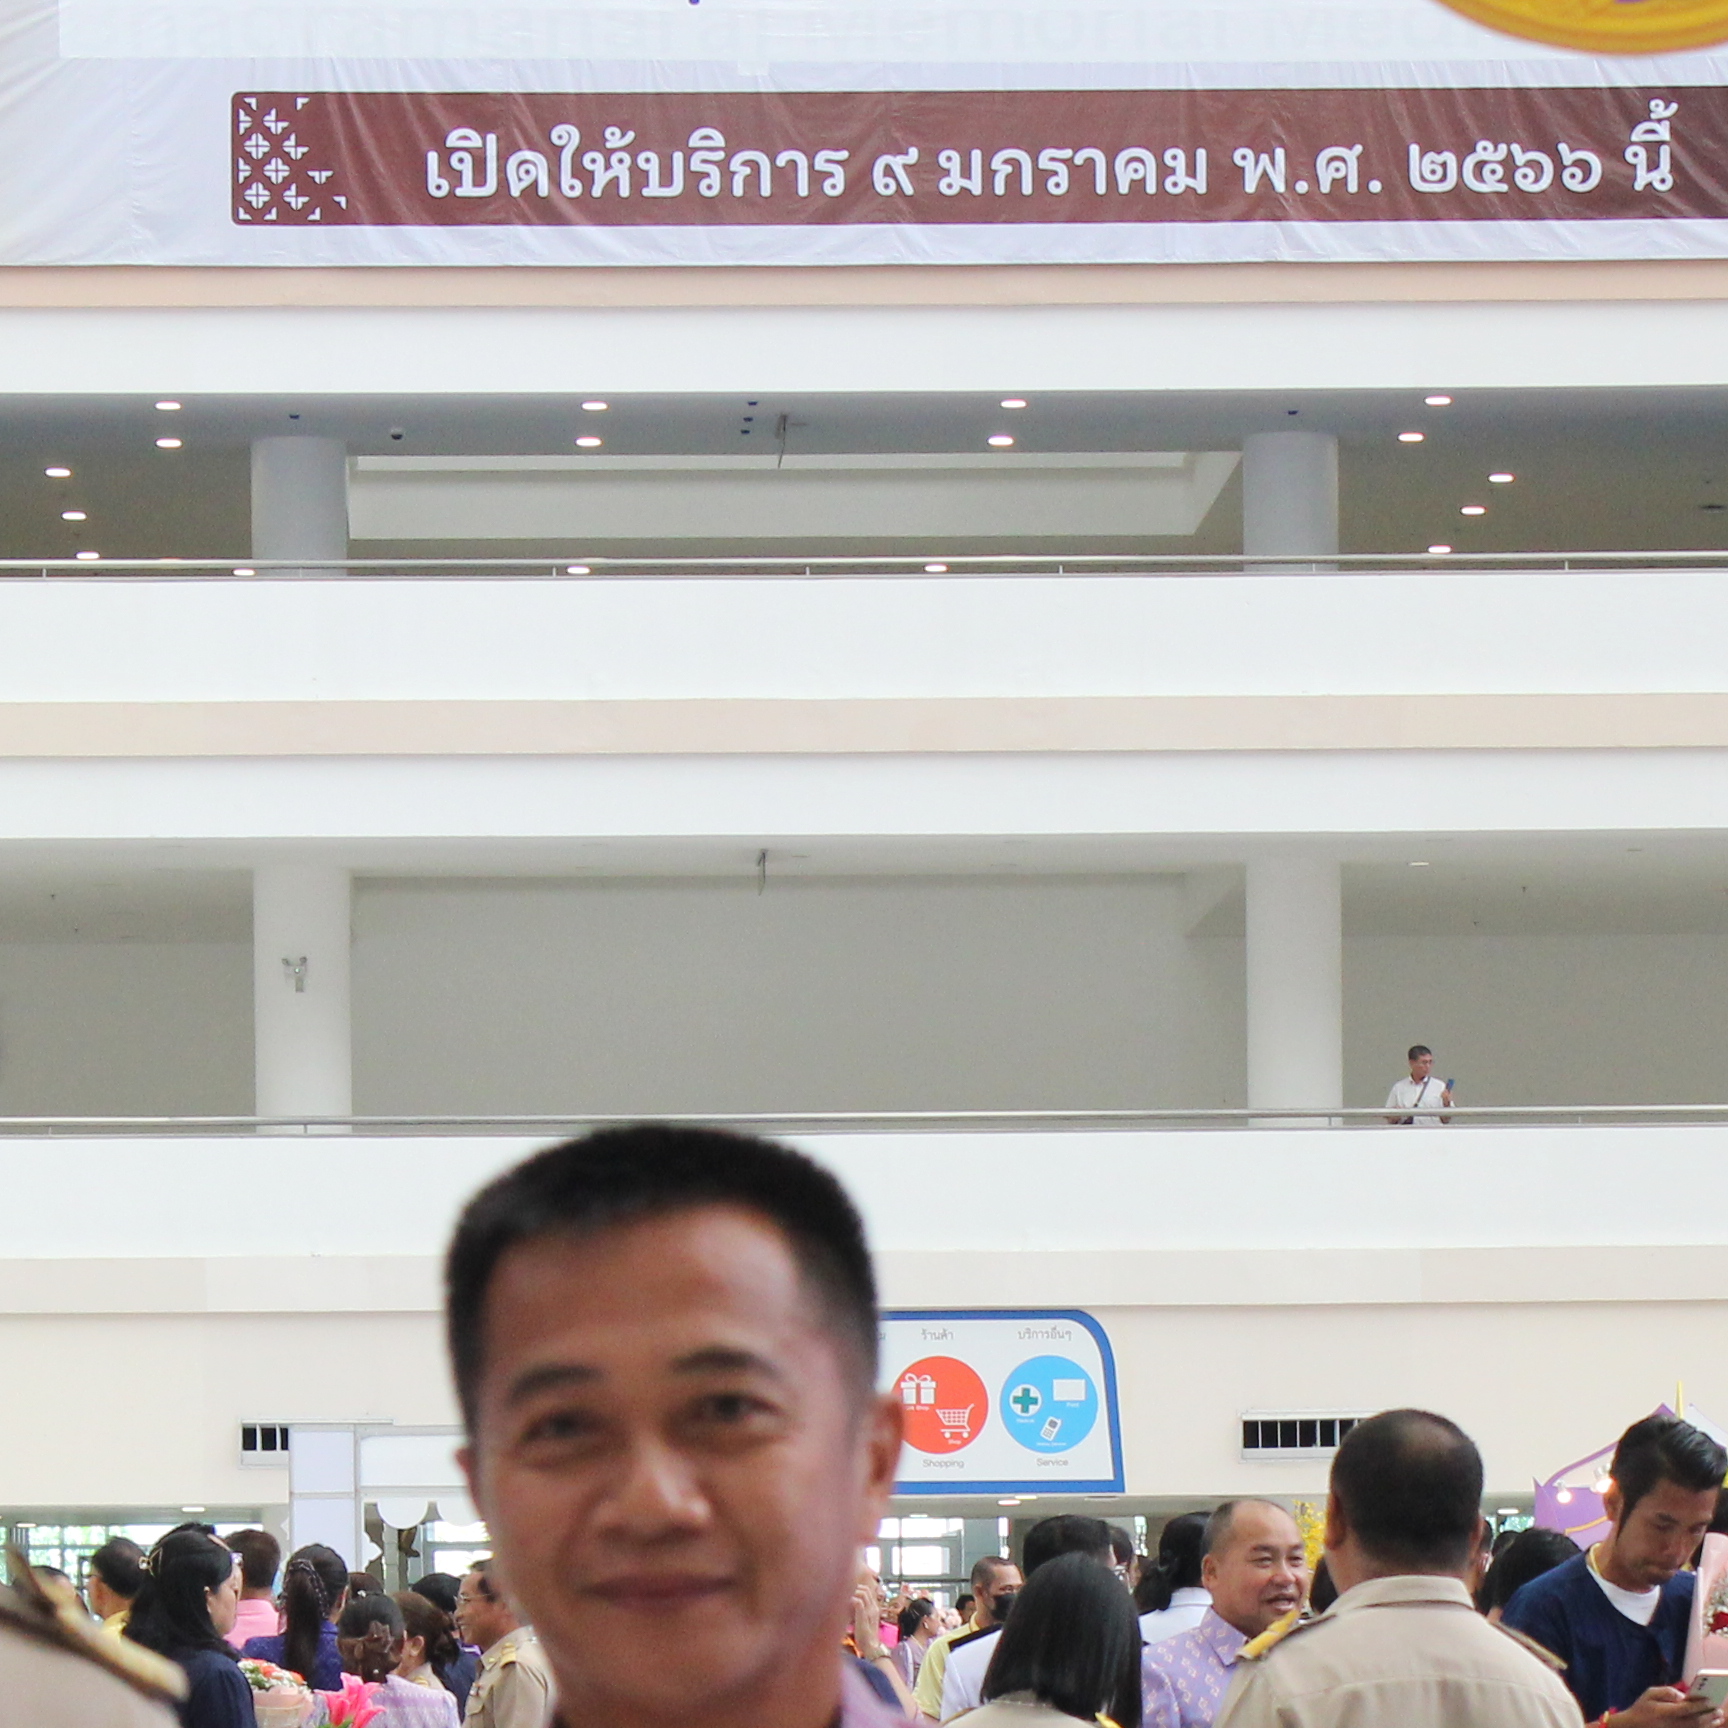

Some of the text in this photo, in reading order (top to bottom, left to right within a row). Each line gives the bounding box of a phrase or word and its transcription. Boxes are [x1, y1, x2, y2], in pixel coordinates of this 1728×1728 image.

[426, 97, 1678, 199] เปิดให้บริการ ๙ มกราคม พ.ศ. ๒๕๖๖ นี้
[922, 1458, 965, 1469] Shopping
[1036, 1458, 1069, 1467] Service
